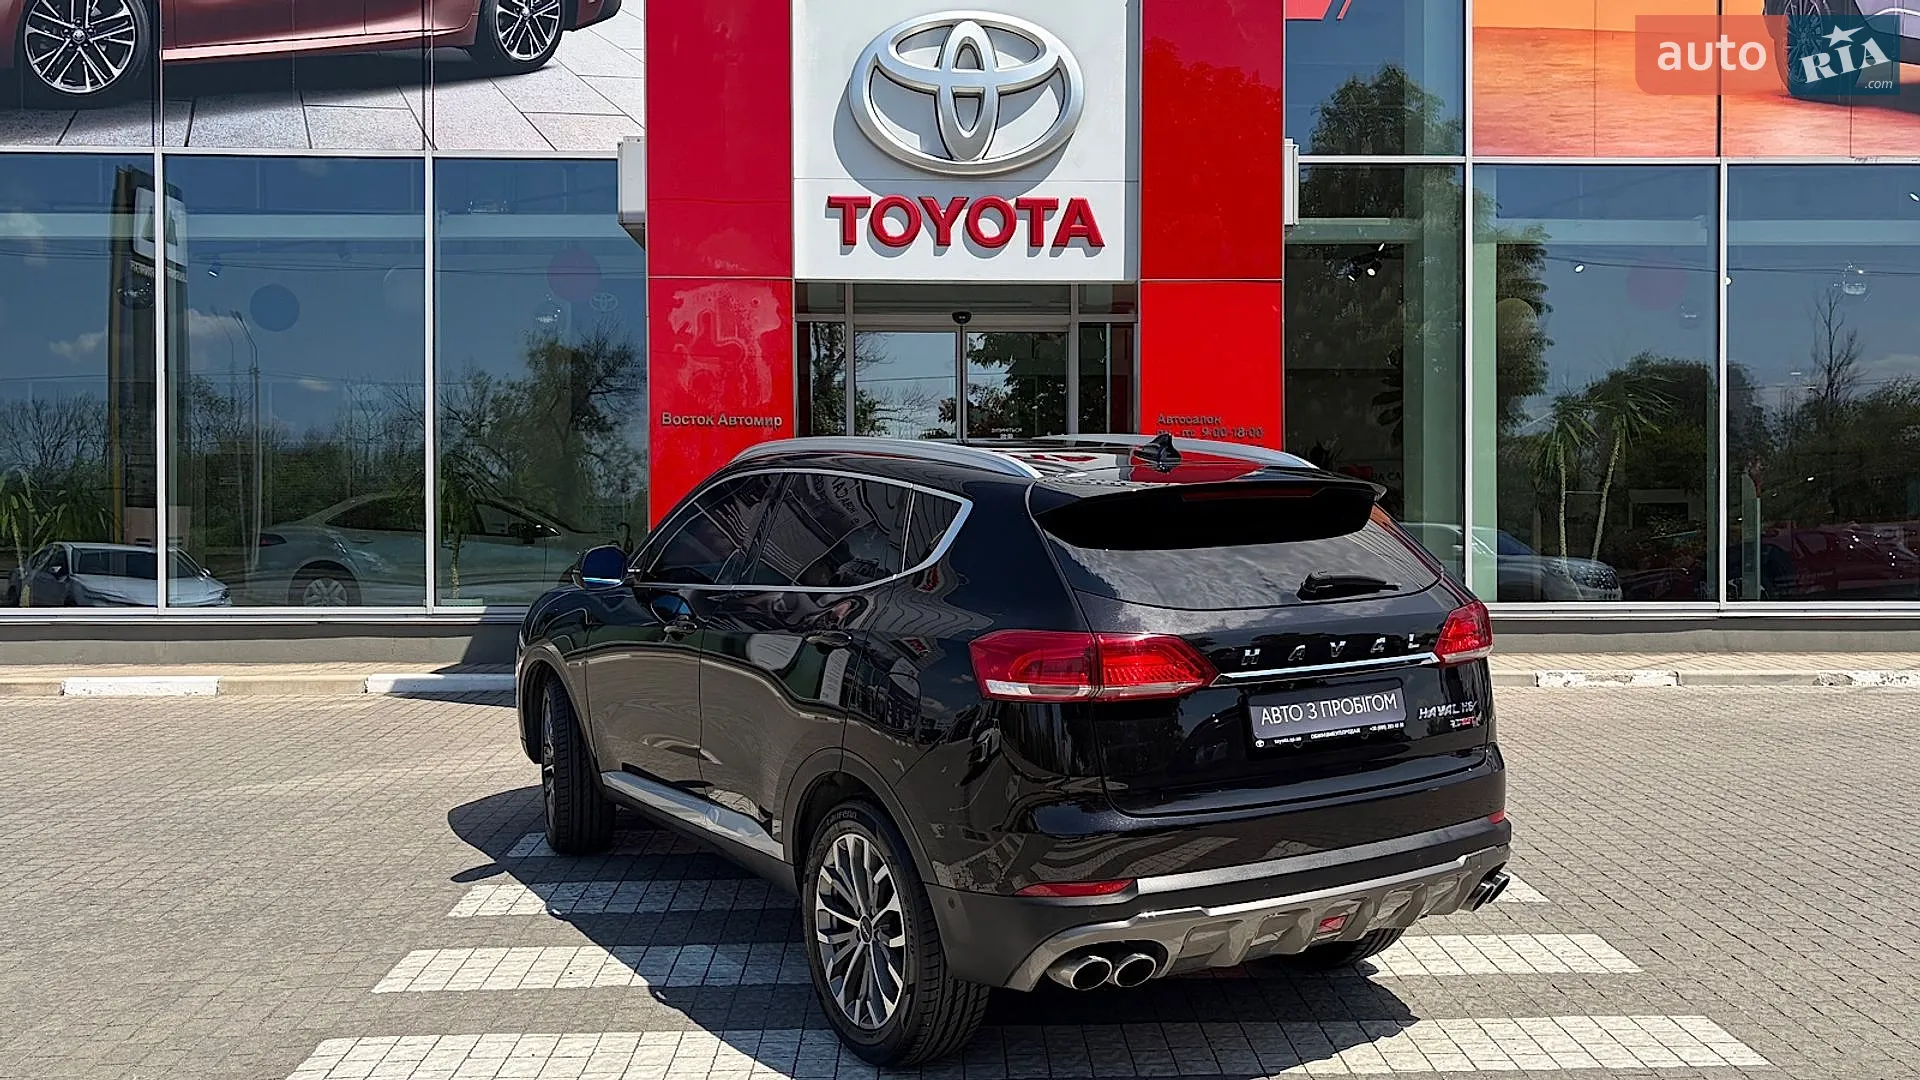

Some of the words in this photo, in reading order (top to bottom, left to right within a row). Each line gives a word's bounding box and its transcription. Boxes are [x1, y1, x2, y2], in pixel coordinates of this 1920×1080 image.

[827, 194, 1106, 249] TOYOTA
[662, 412, 714, 425] Восток
[717, 413, 783, 430] Автомир
[1157, 414, 1222, 425] Автосалон
[1241, 632, 1420, 666] HAVAL
[1261, 704, 1304, 725] АВТО
[1320, 692, 1398, 718] ПРОБІГОМ
[1418, 703, 1460, 720] HAVAL
